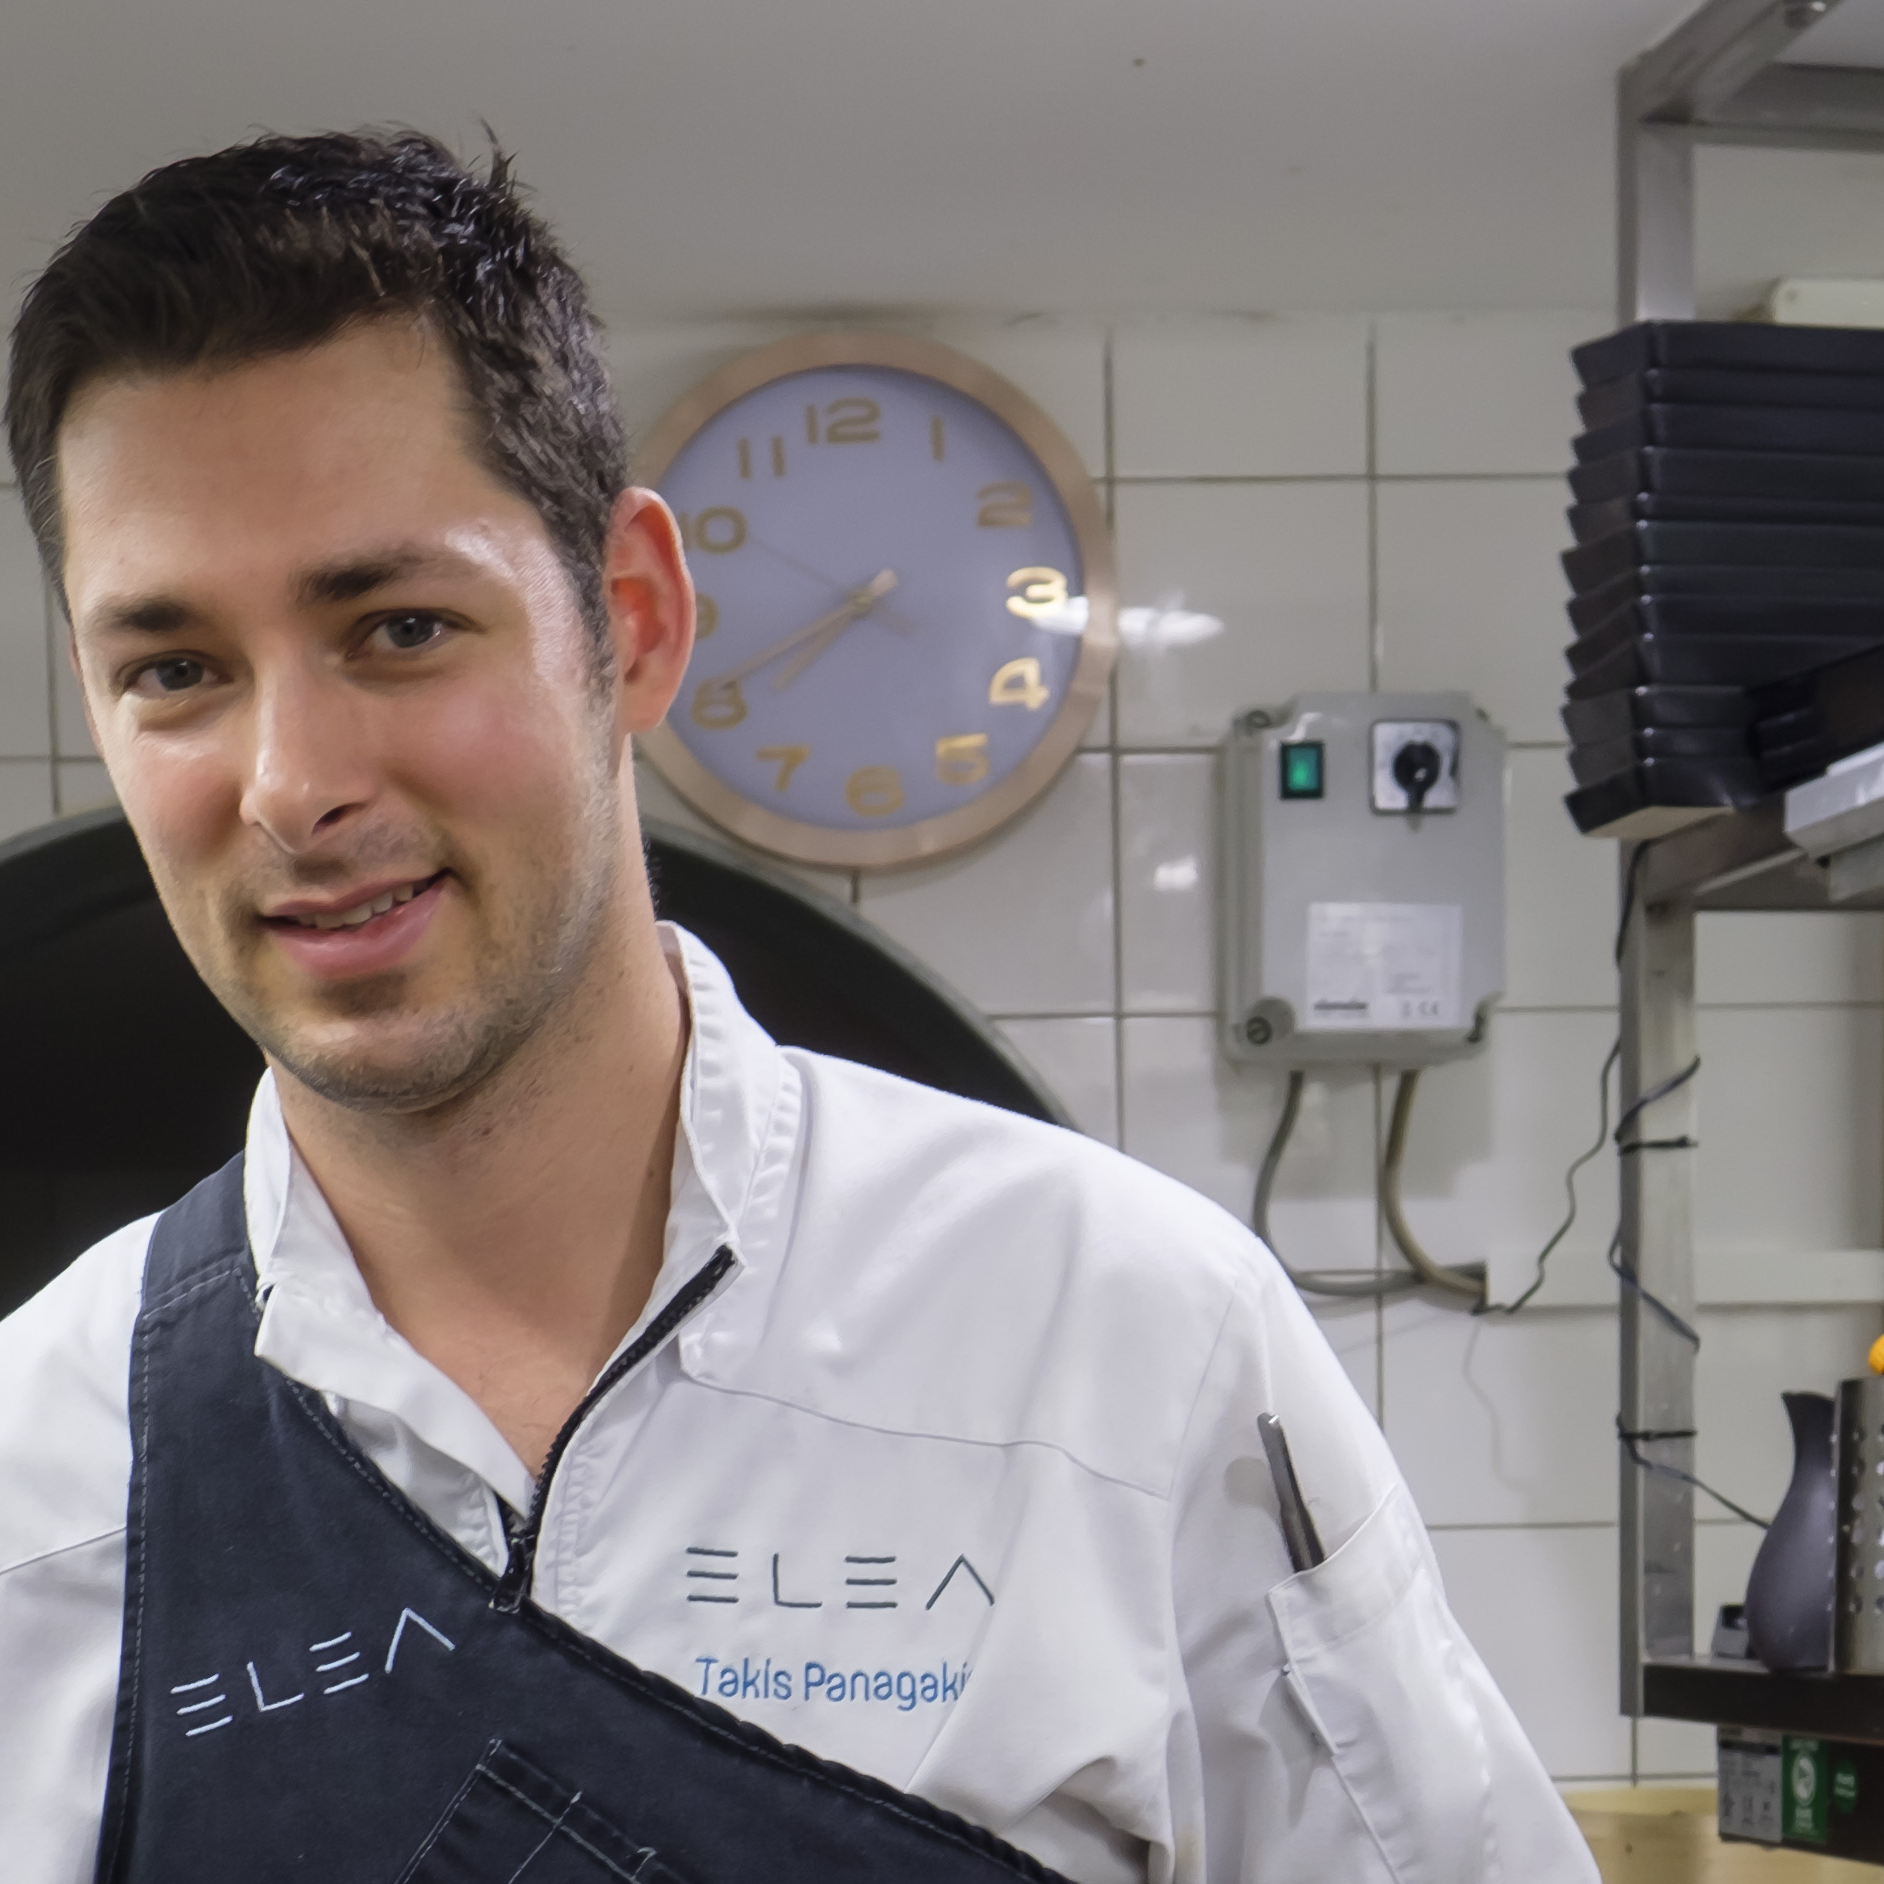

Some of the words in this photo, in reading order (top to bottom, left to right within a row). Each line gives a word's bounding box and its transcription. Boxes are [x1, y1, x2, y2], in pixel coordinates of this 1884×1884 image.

[806, 397, 881, 444] 12
[929, 416, 945, 461] 1
[737, 436, 785, 479] 11
[975, 481, 1032, 528] 2
[679, 506, 748, 555] 10
[1005, 566, 1068, 619] 3
[691, 676, 748, 730] 8
[988, 658, 1049, 710] 4
[755, 745, 810, 792] 7
[935, 733, 991, 786] 5
[845, 765, 905, 818] 6
[695, 1656, 793, 1700] Takis
[803, 1656, 973, 1712] Panagaki
